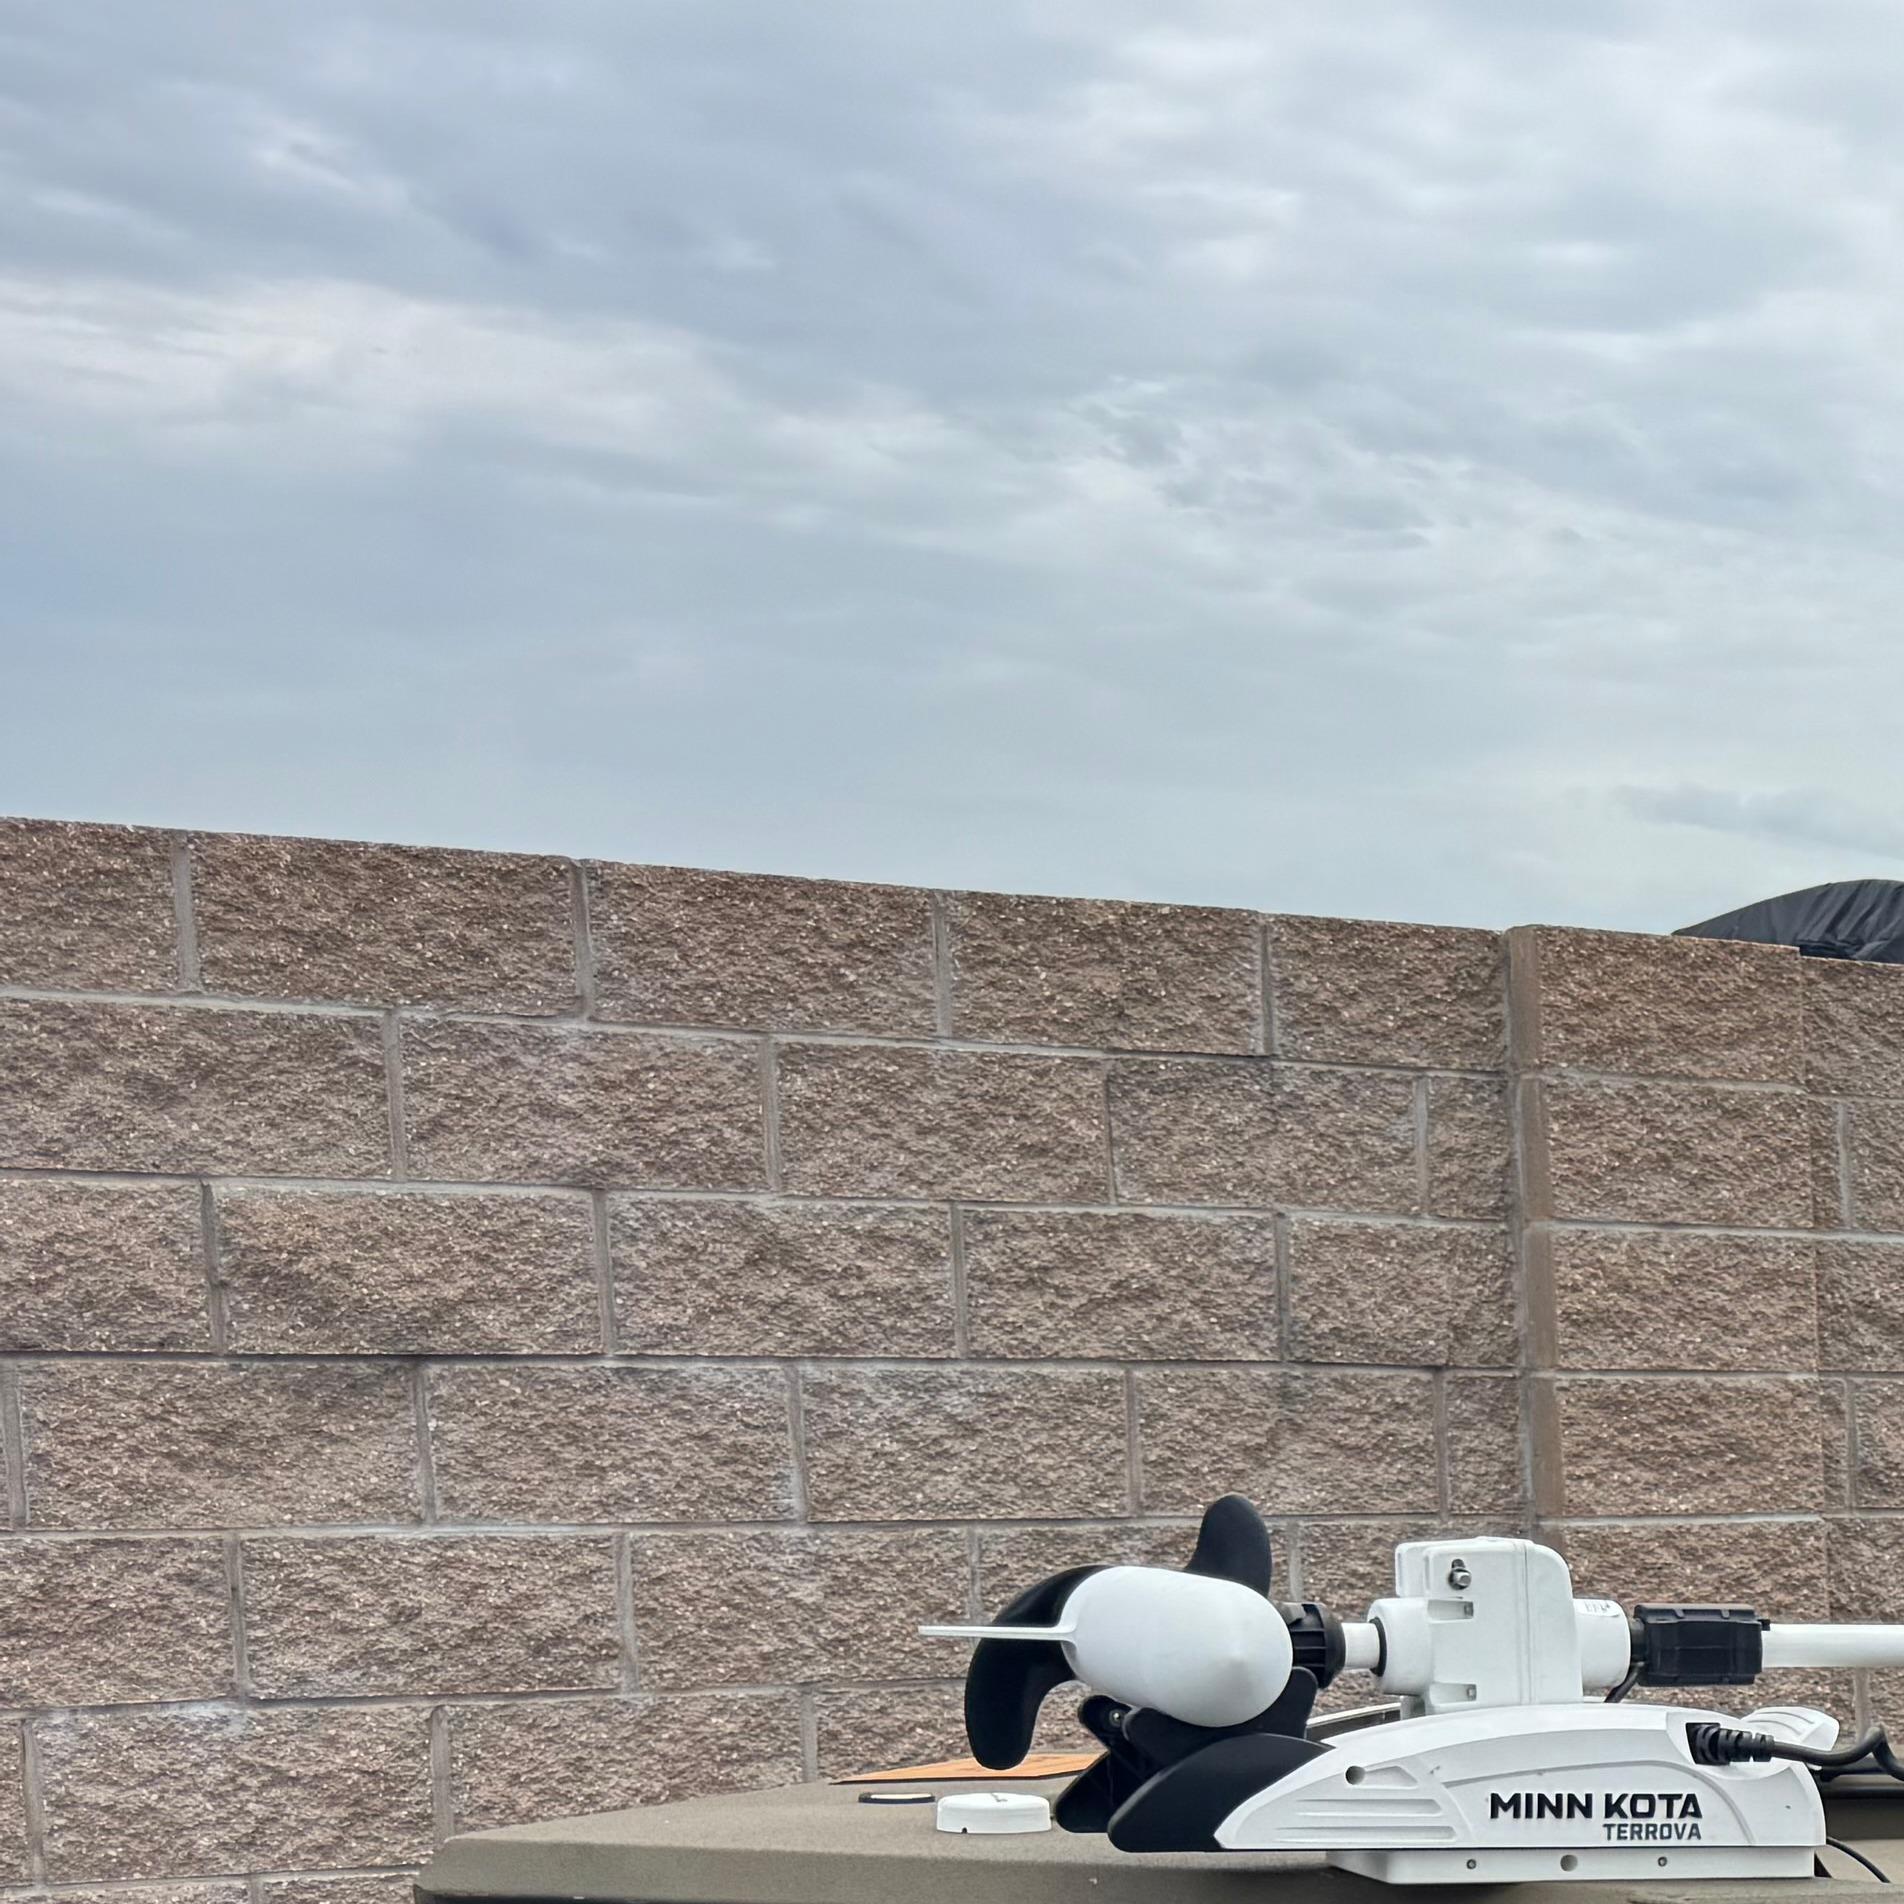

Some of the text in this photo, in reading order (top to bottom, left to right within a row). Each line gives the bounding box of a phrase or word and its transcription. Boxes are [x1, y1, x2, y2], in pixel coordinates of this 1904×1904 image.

[1490, 1793, 1703, 1819] MINN KOTA
[1602, 1823, 1702, 1840] TERROVA
